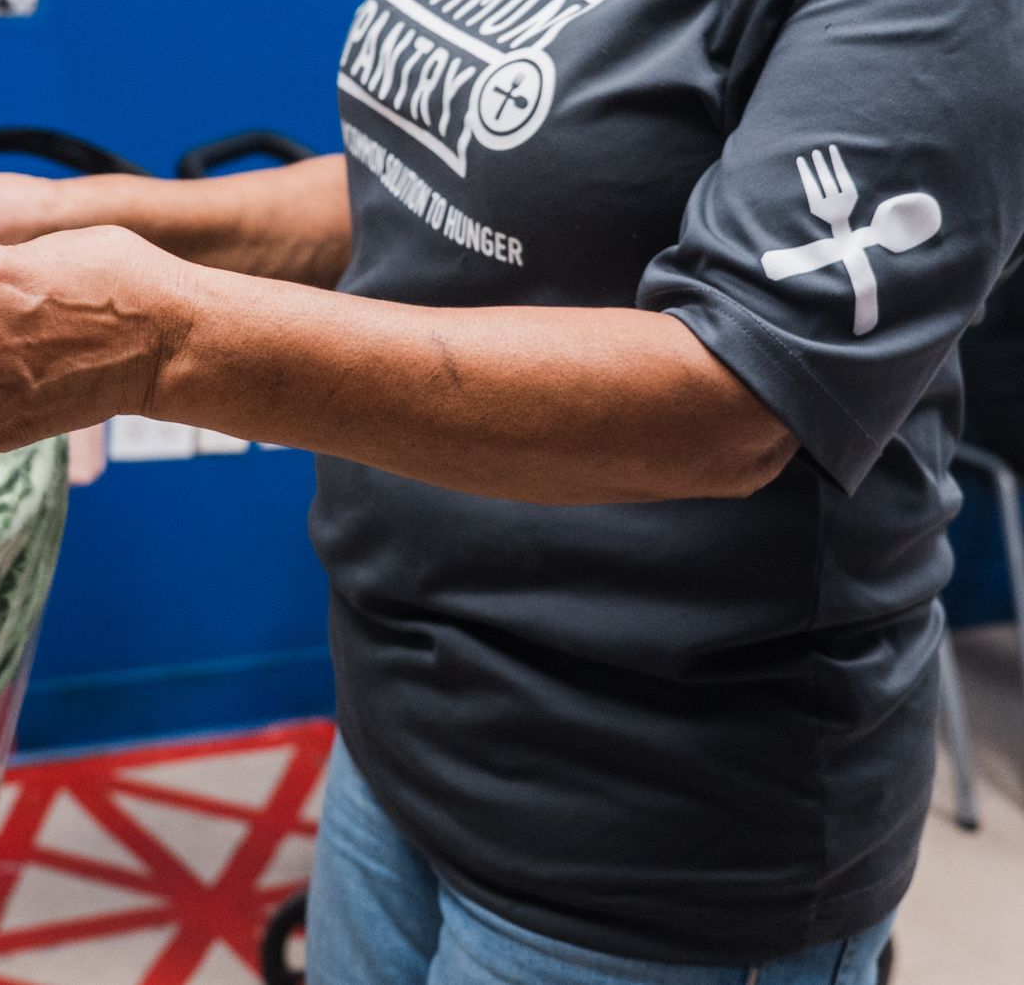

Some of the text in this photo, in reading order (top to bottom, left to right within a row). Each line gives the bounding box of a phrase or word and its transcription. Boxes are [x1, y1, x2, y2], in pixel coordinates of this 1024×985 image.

[340, 0, 476, 138] PANTRY
[425, 191, 448, 231] TO
[443, 204, 524, 267] HUNGER
